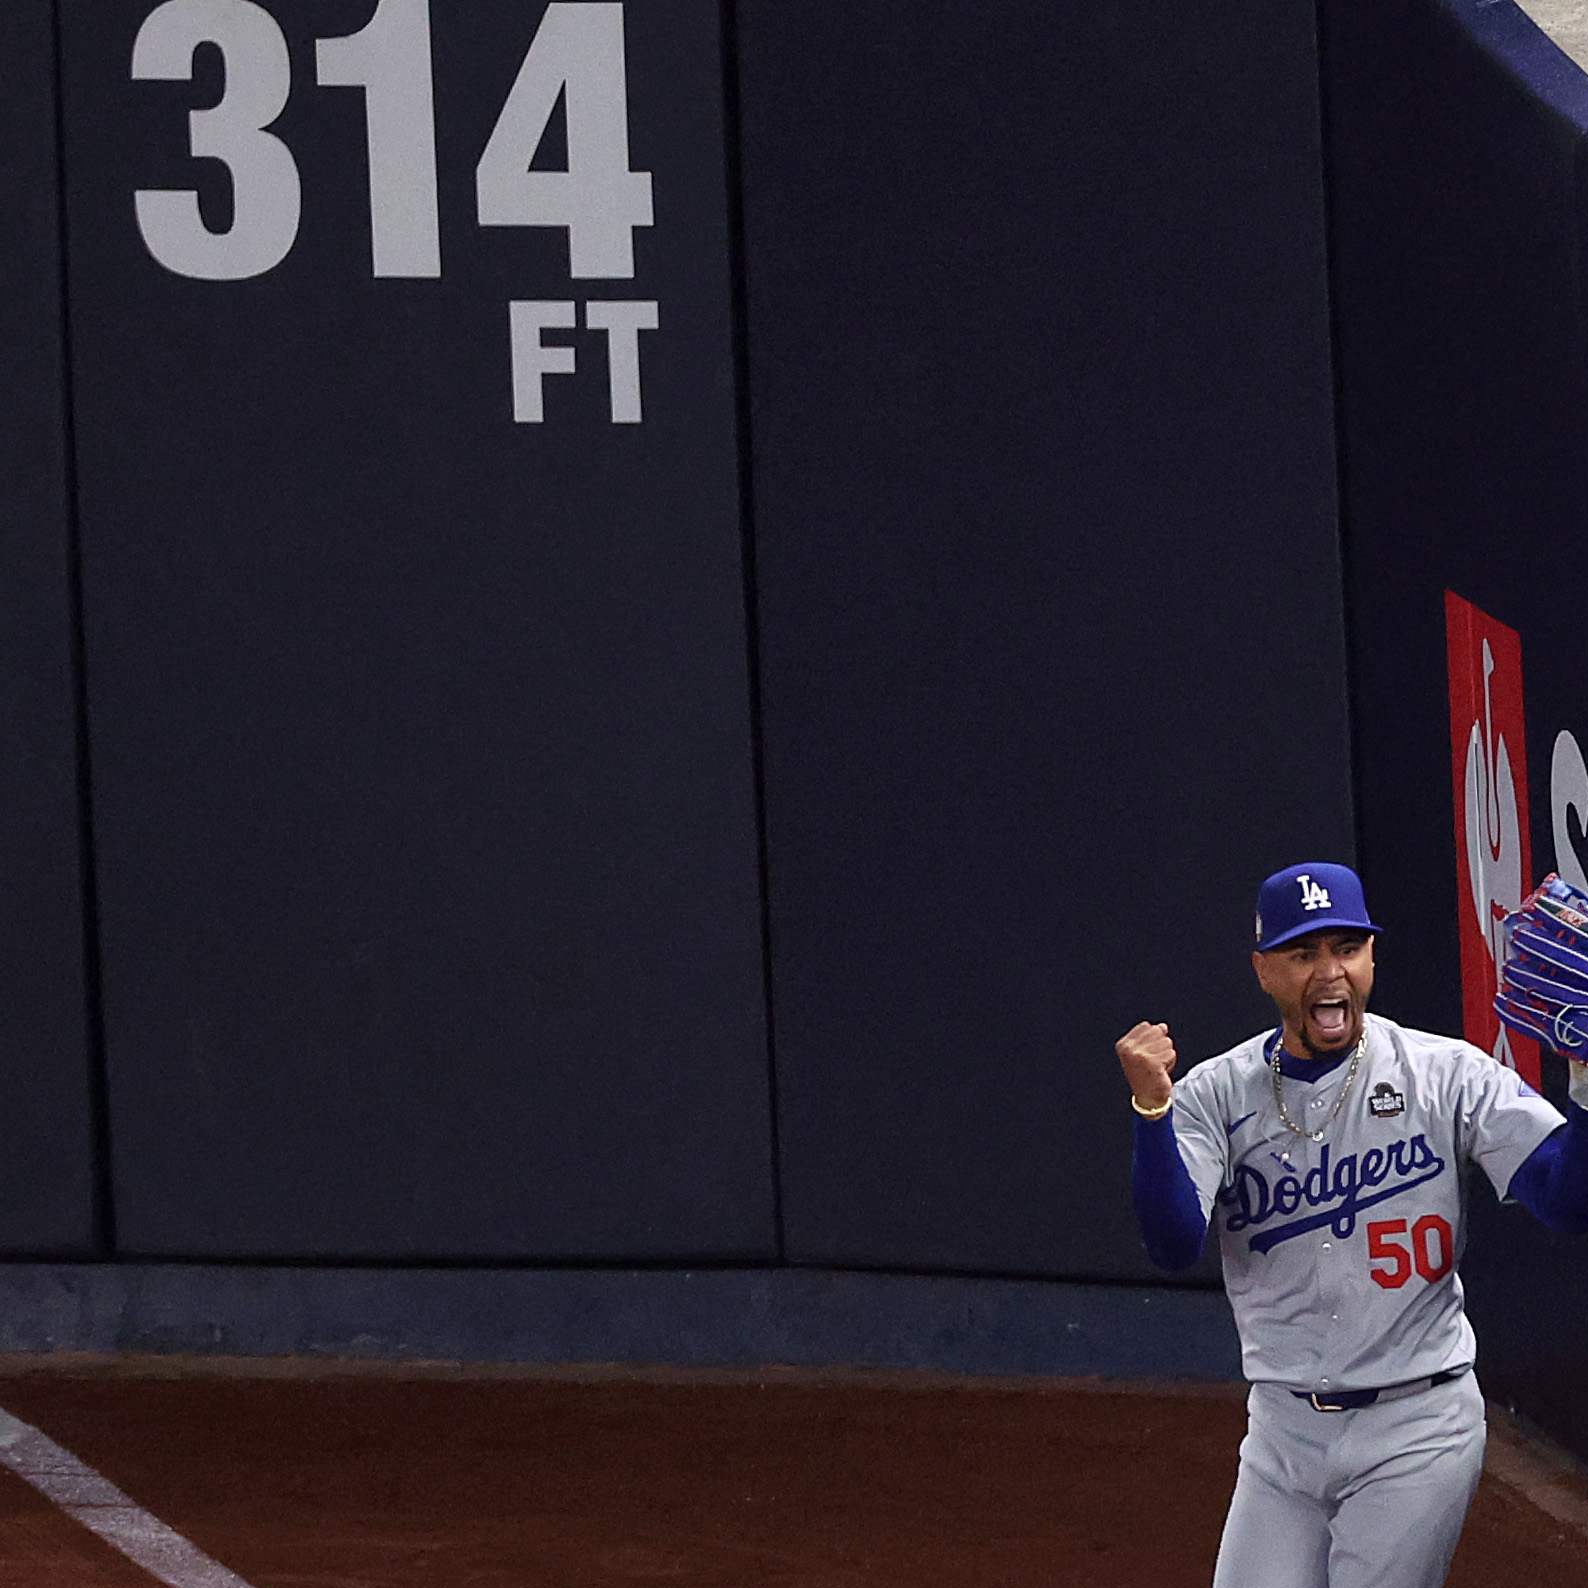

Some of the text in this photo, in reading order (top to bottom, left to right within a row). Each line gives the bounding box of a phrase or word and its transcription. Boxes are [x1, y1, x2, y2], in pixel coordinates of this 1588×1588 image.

[130, 0, 655, 280] 314
[510, 301, 659, 423] FT
[1296, 875, 1331, 911] LA
[1218, 1133, 1445, 1255] Dodgers
[1366, 1213, 1454, 1289] 50
